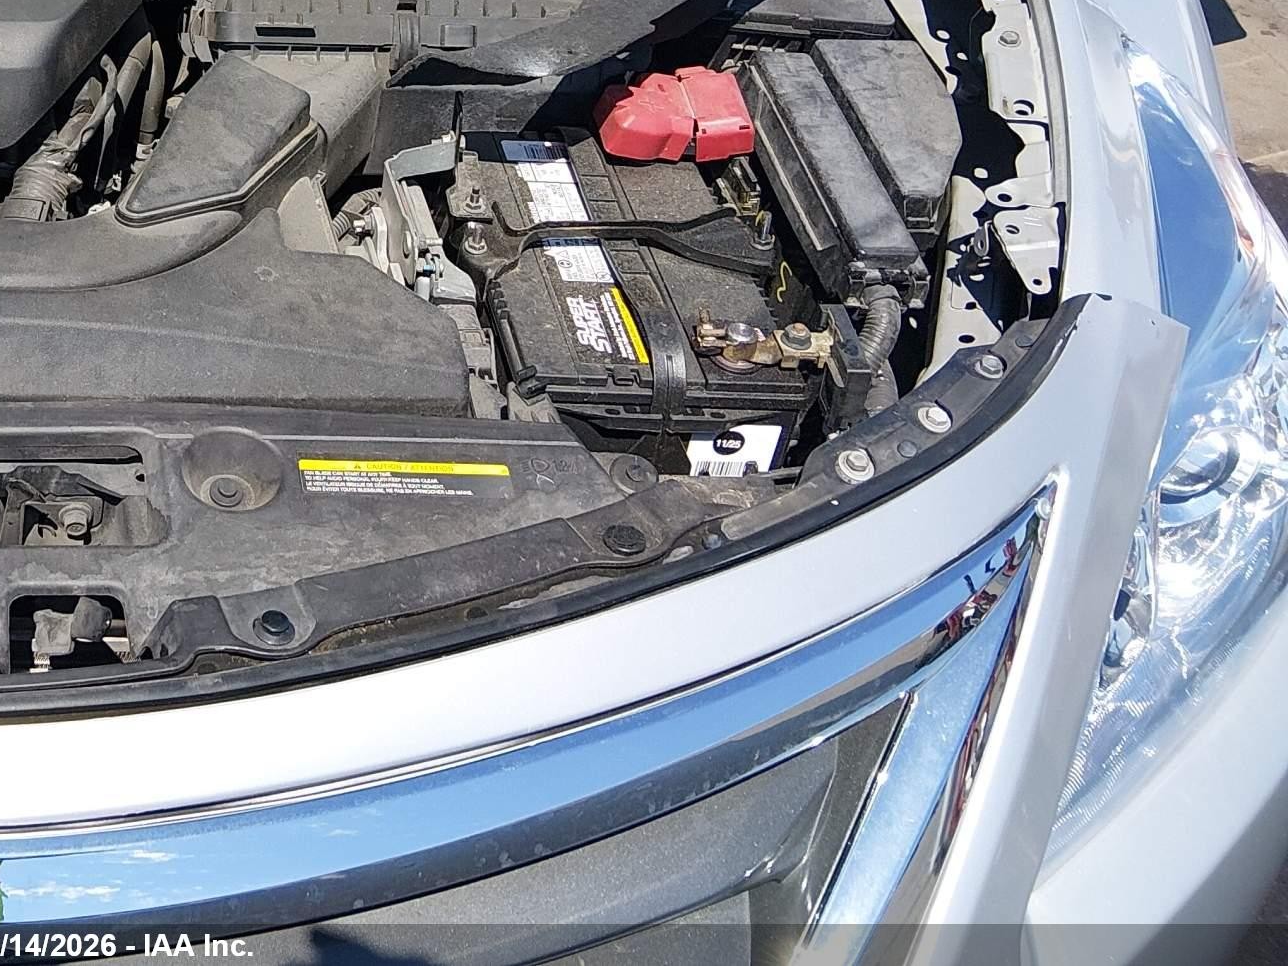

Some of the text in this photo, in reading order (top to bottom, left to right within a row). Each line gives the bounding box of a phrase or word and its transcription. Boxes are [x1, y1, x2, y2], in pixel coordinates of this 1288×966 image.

[566, 295, 591, 346] SUPER
[583, 297, 613, 354] START
[716, 438, 742, 449] 11/25
